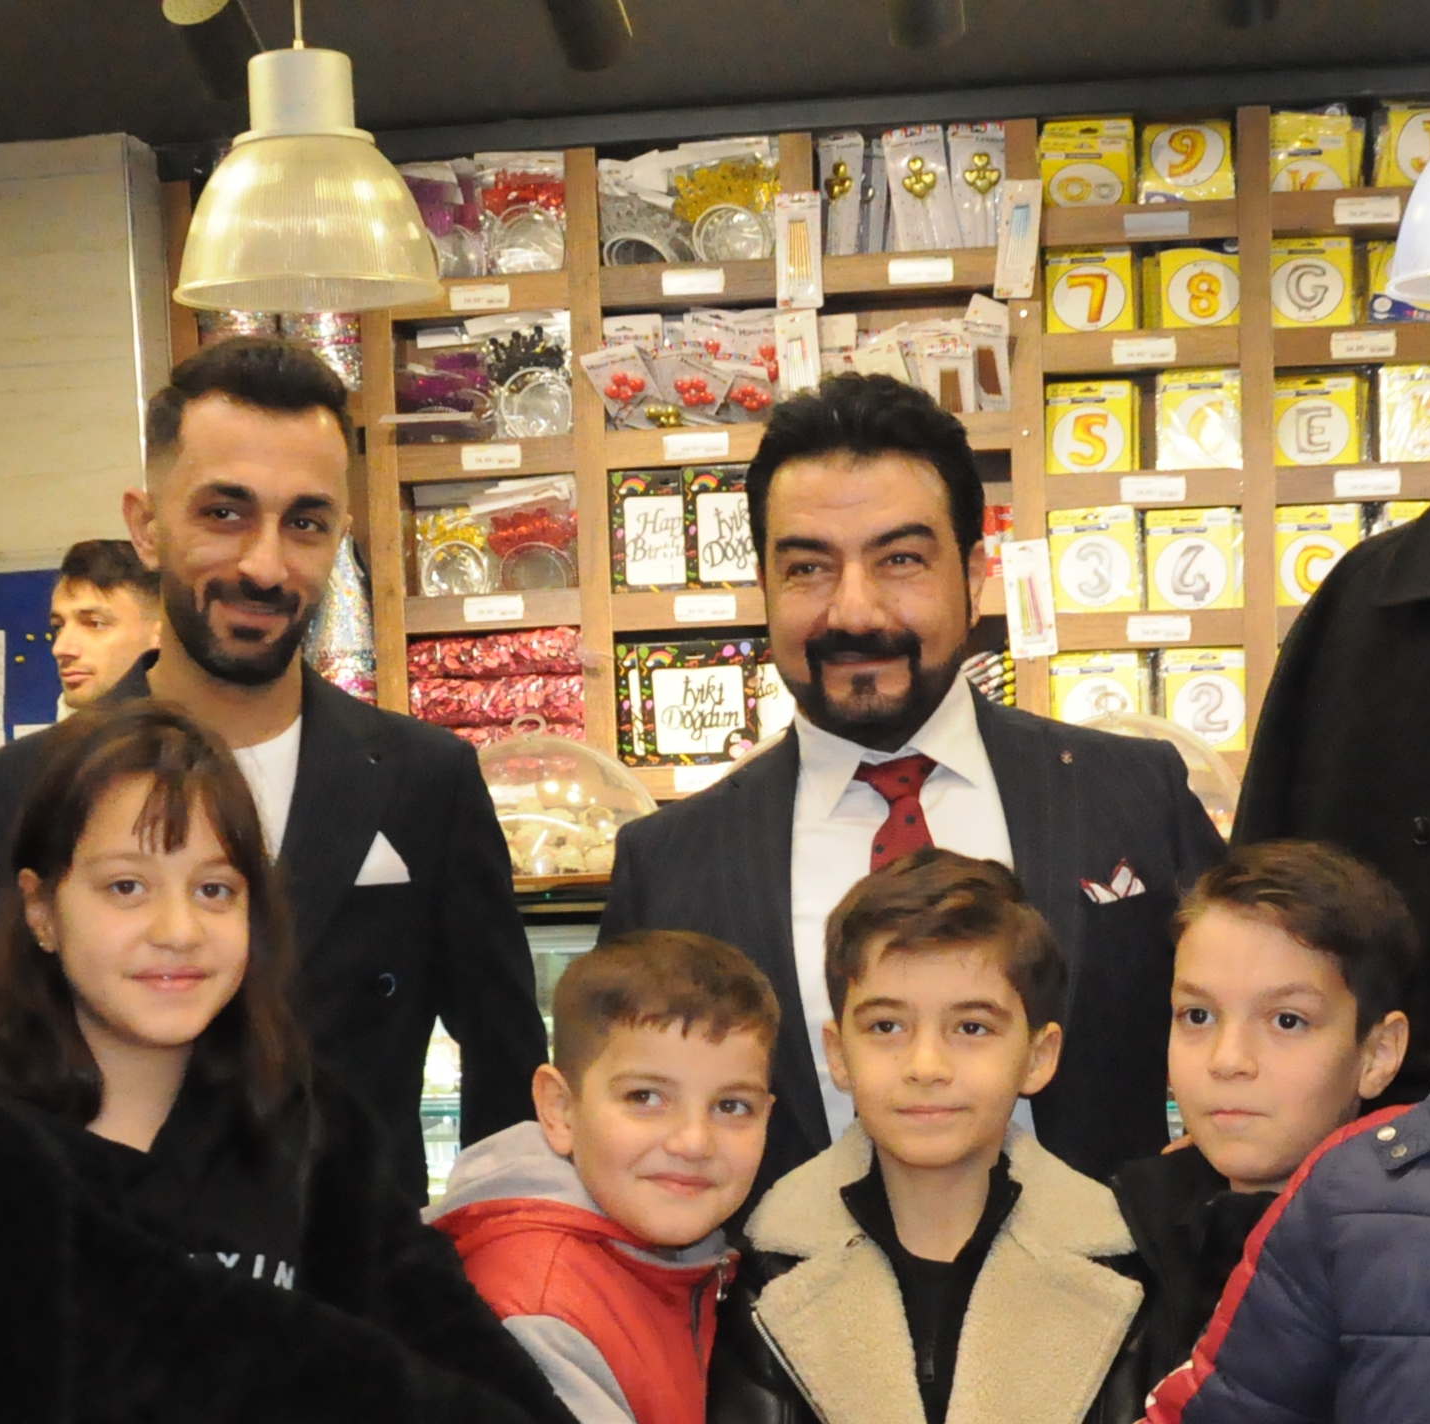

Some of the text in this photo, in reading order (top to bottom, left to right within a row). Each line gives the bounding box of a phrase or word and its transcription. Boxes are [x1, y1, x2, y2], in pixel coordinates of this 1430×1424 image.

[1067, 273, 1110, 324] 7
[1186, 272, 1222, 318] 8
[1287, 264, 1329, 312] G
[1296, 406, 1331, 455] E
[1076, 542, 1112, 598] 3
[1295, 544, 1336, 594] C
[1190, 681, 1228, 732] 2
